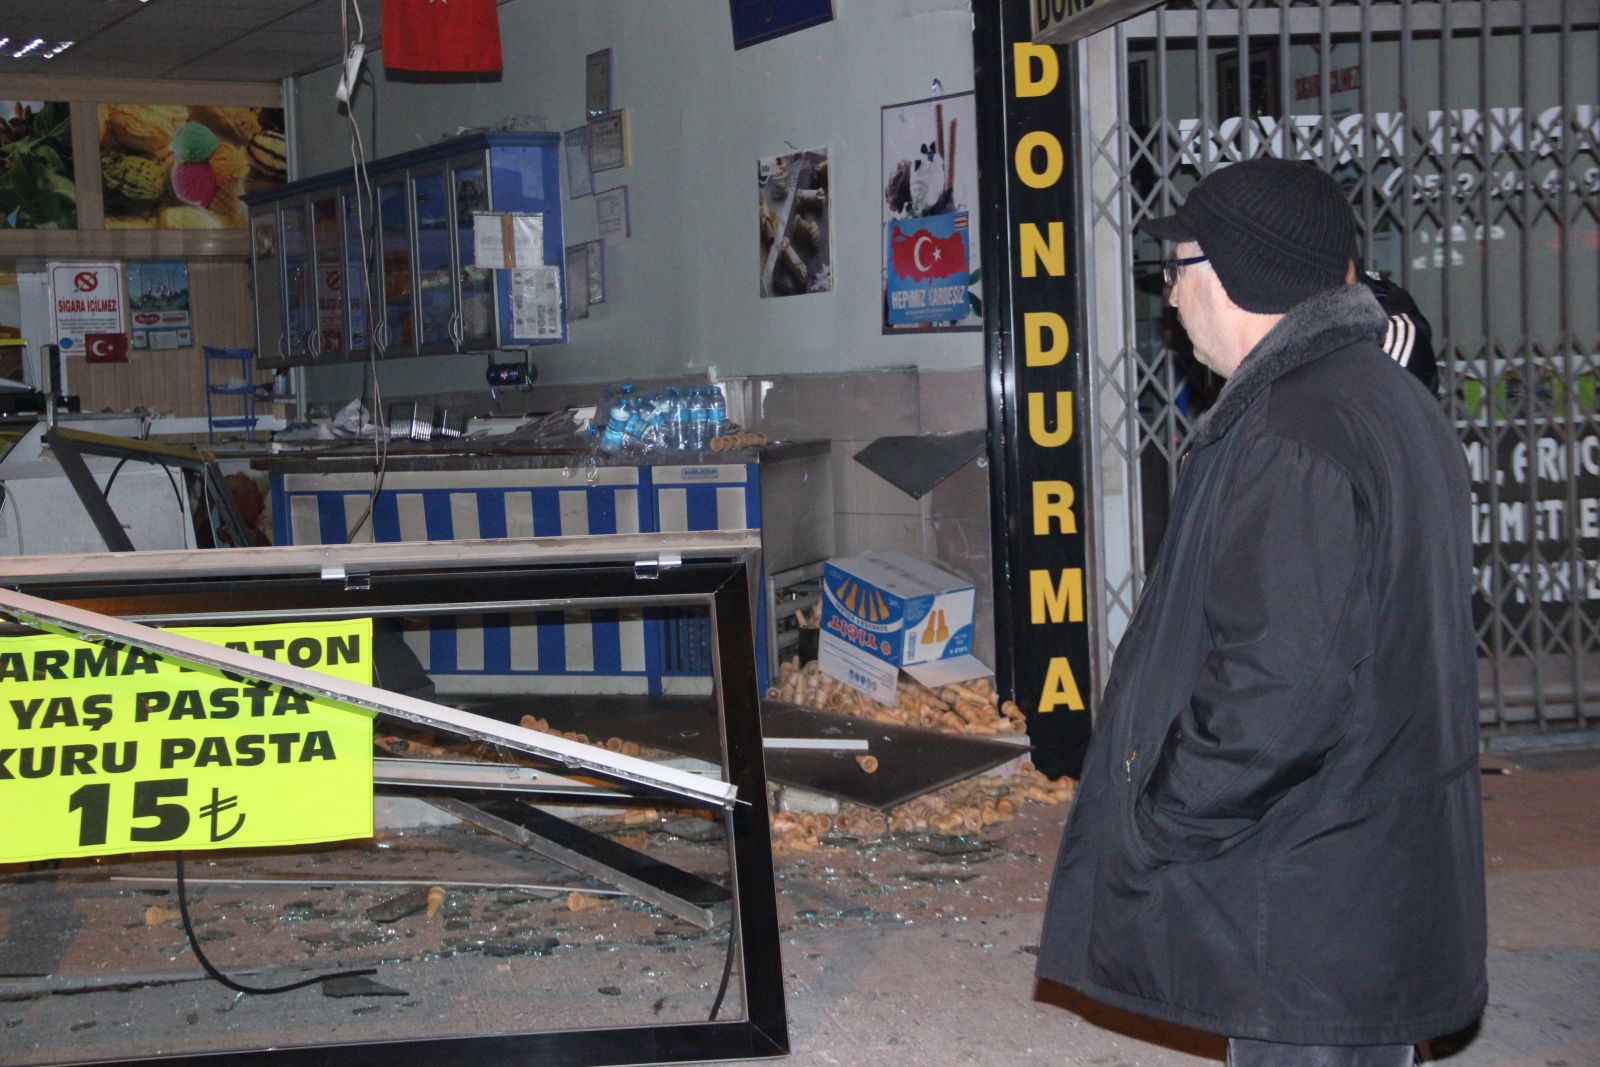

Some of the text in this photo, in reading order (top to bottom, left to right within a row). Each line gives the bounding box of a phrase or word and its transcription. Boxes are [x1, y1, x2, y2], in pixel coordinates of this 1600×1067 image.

[58, 297, 85, 313] SİGARA
[1013, 42, 1085, 713] DONDURMA
[179, 634, 361, 673] TON
[9, 686, 311, 731] YAŞ PASTA
[160, 730, 337, 769] PASTA
